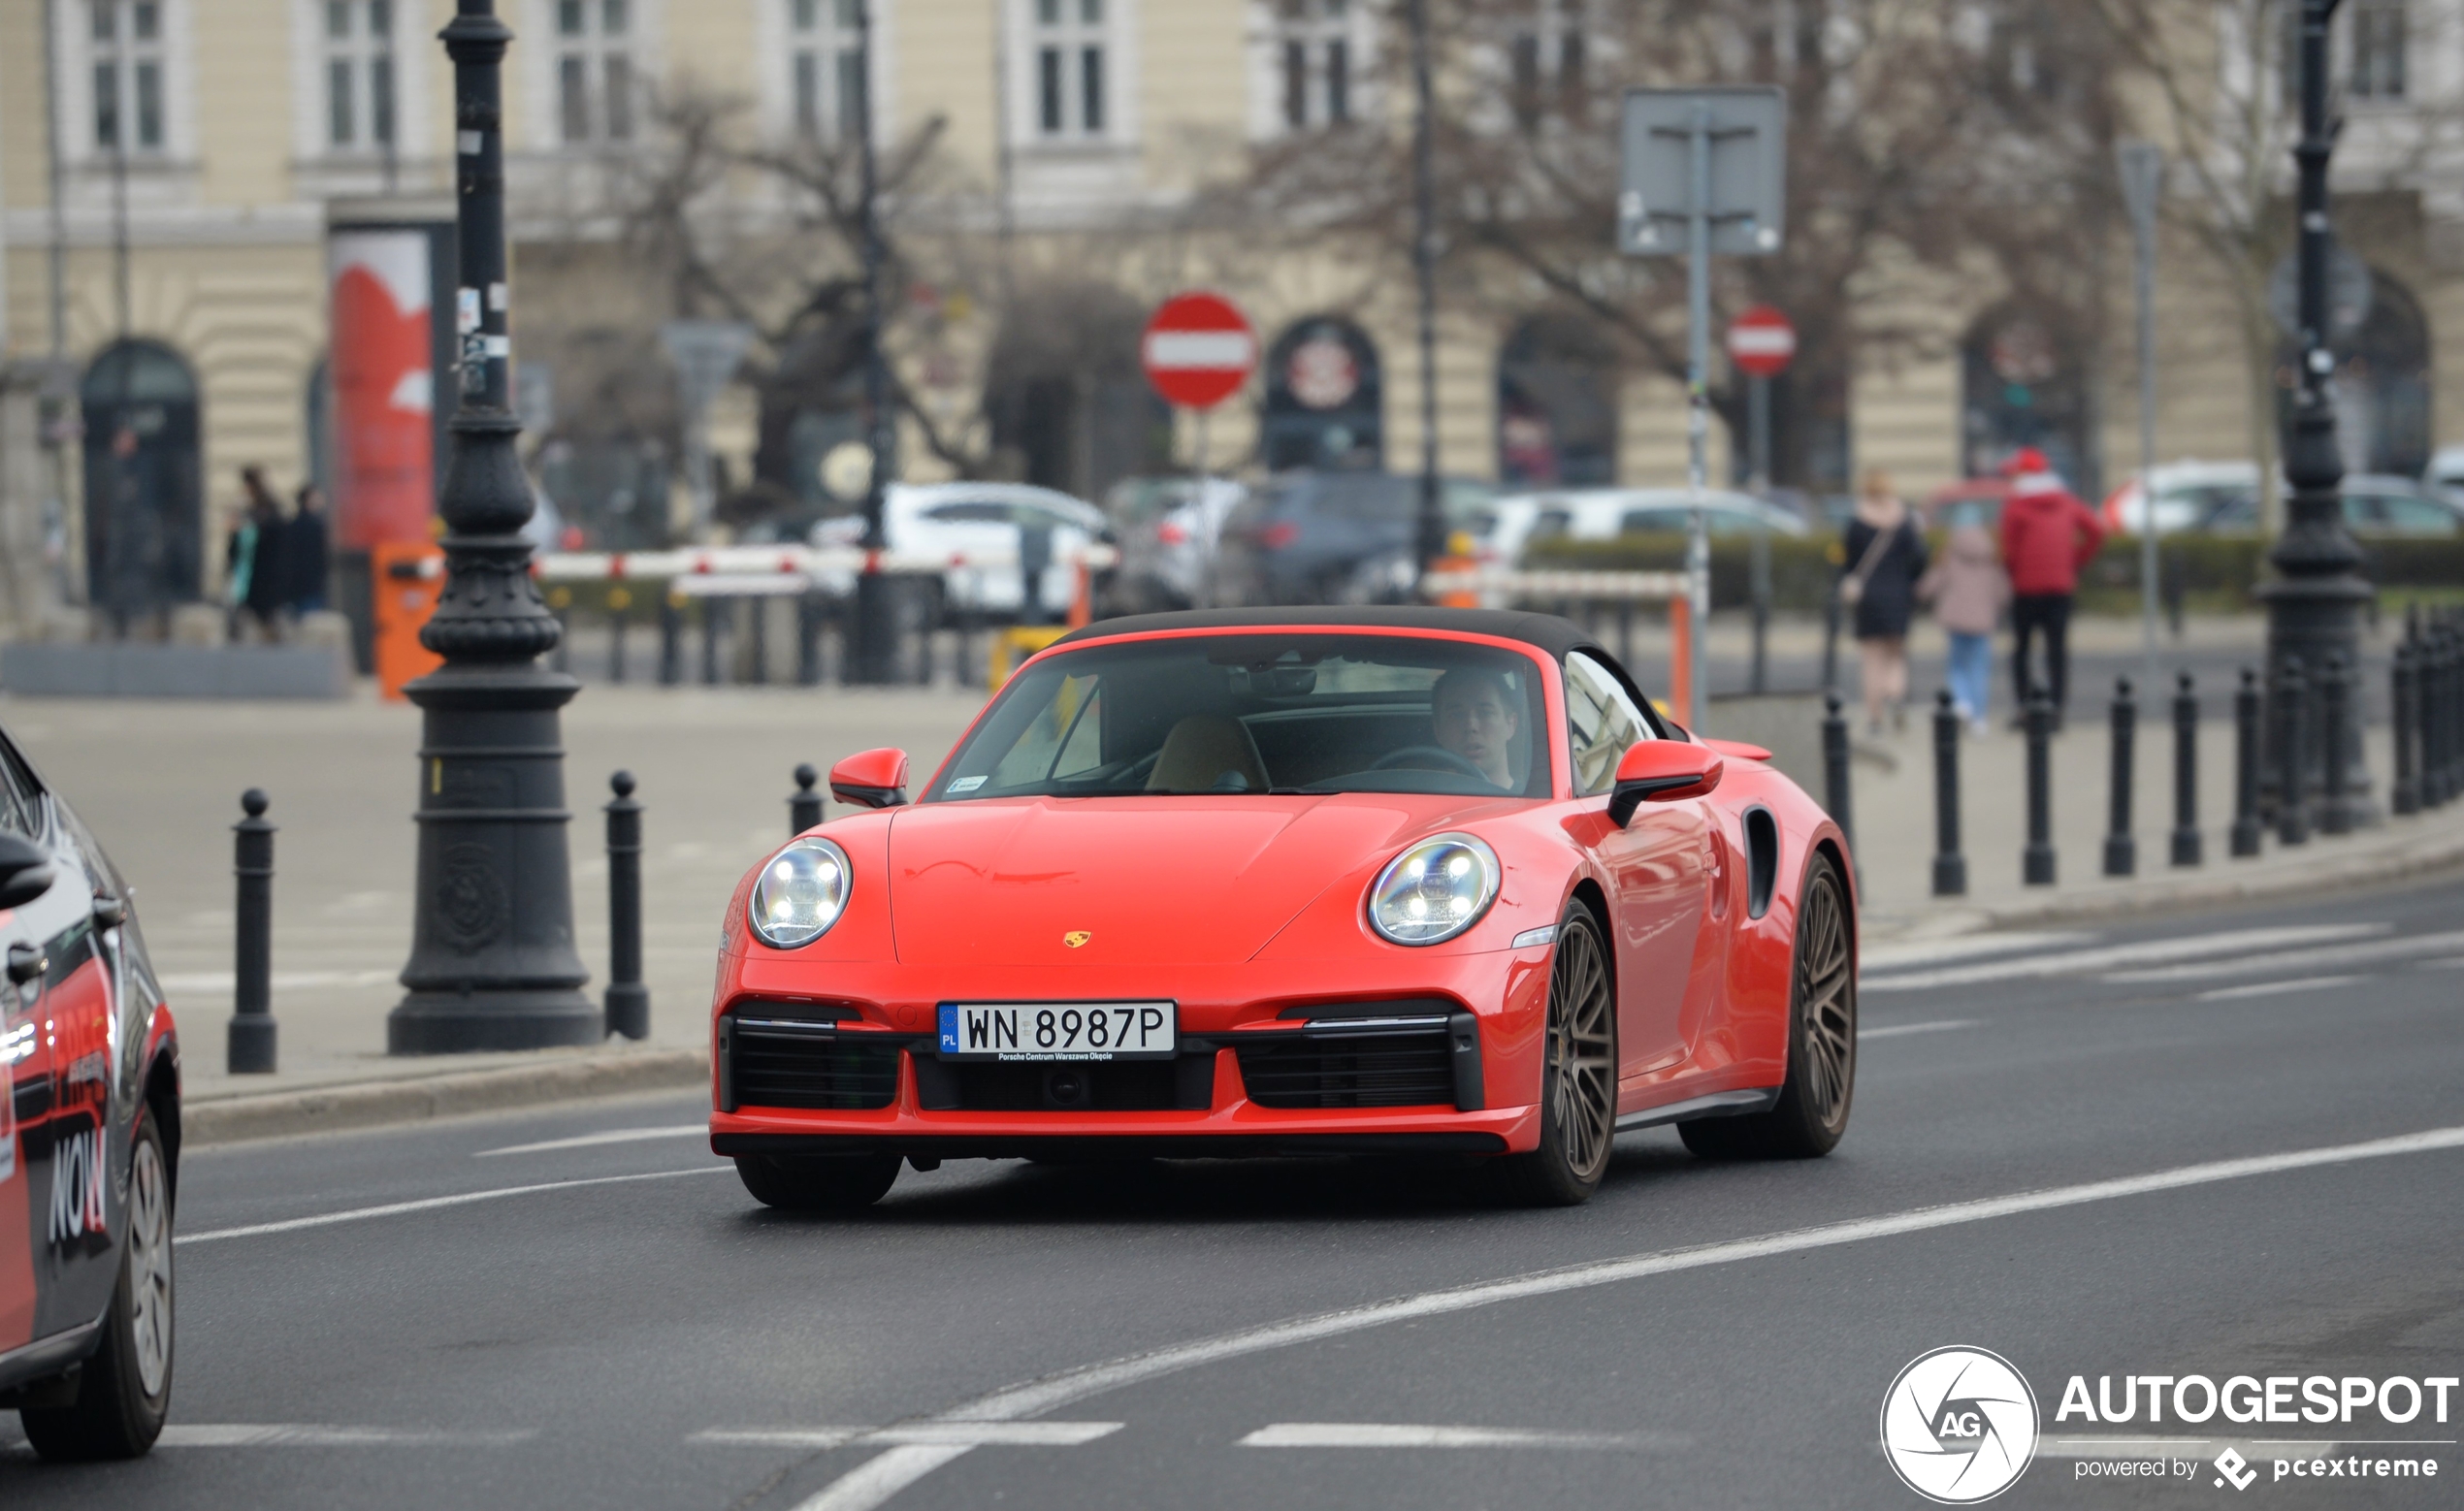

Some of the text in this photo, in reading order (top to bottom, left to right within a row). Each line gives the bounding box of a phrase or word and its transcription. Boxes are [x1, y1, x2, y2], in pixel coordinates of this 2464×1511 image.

[942, 1035, 956, 1045] PL
[966, 1008, 1164, 1048] WN 8987P
[998, 1051, 1113, 1062] Porsche Centrum Warszawa Okęcie
[49, 1125, 107, 1242] NOW
